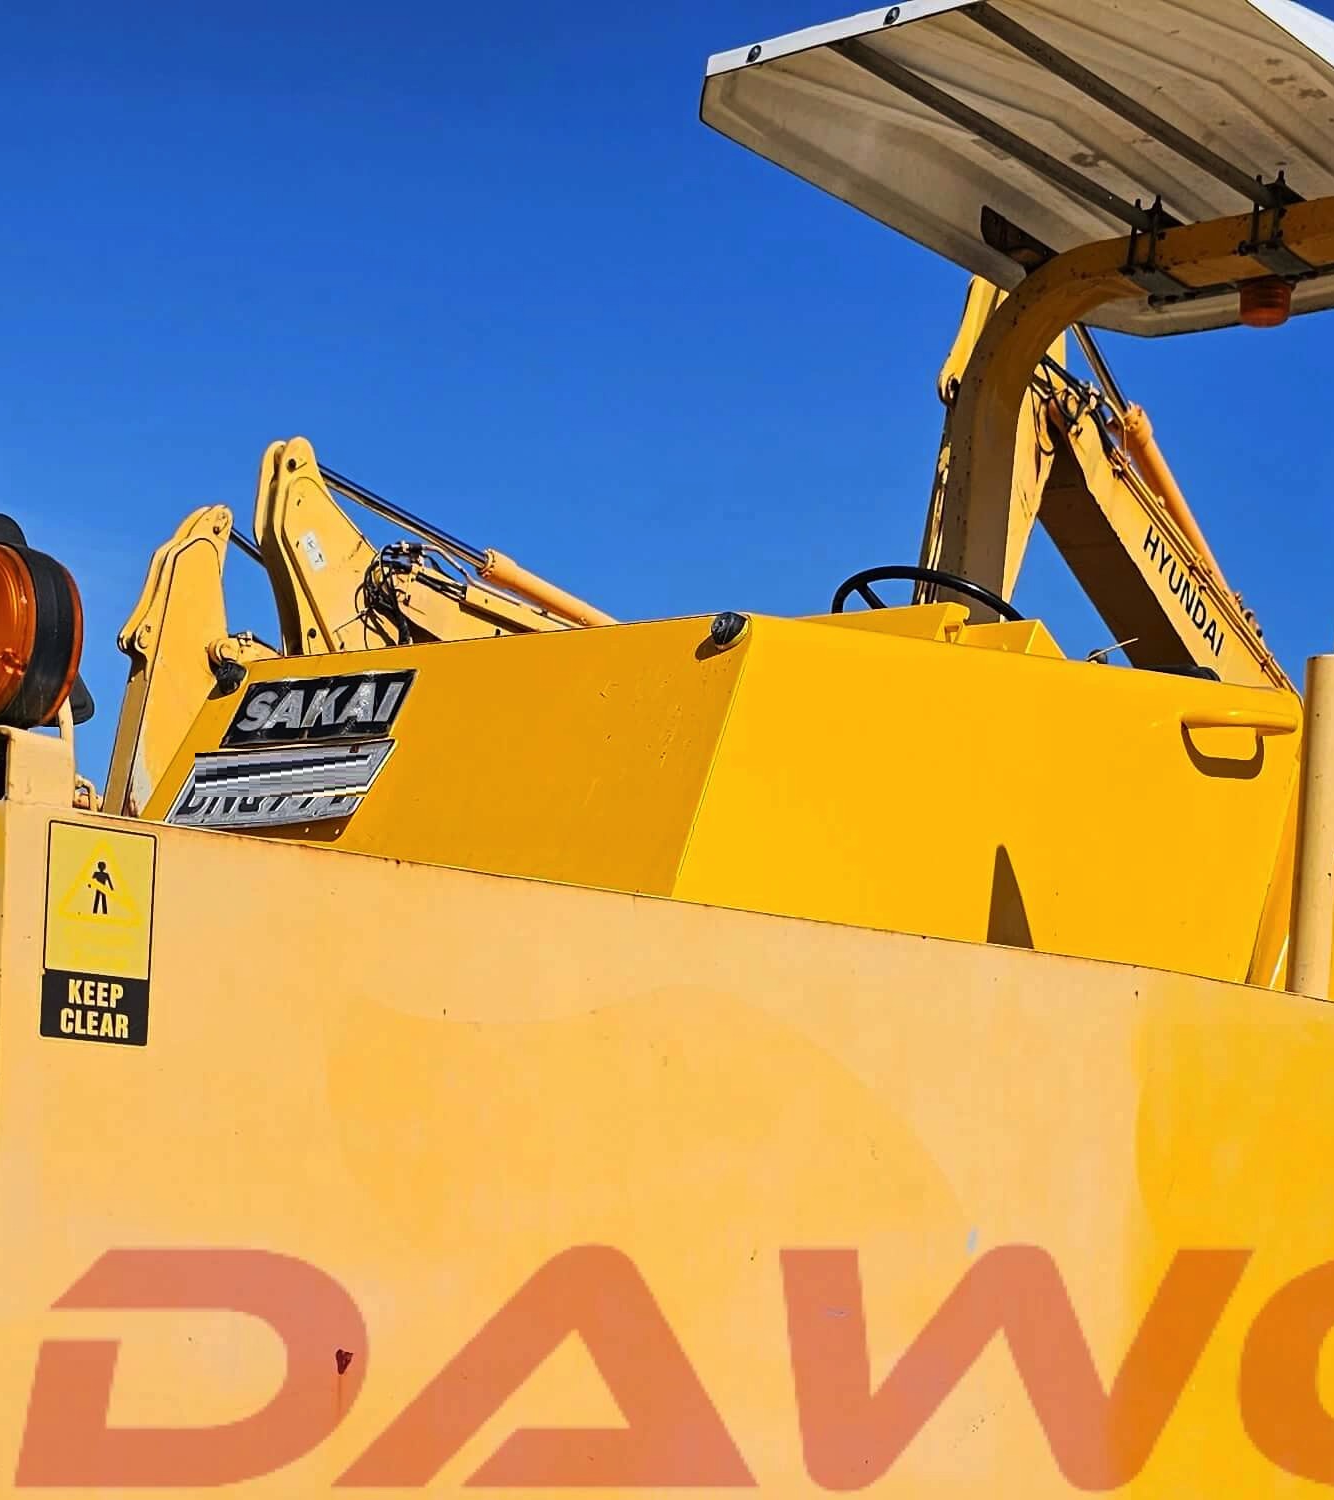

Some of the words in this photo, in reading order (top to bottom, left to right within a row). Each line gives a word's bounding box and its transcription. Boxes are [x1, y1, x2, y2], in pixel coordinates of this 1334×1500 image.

[1143, 524, 1224, 656] HYUNDAI
[236, 681, 405, 732] SAKAI
[68, 978, 124, 1008] KEEP
[60, 1007, 129, 1039] CLEAR
